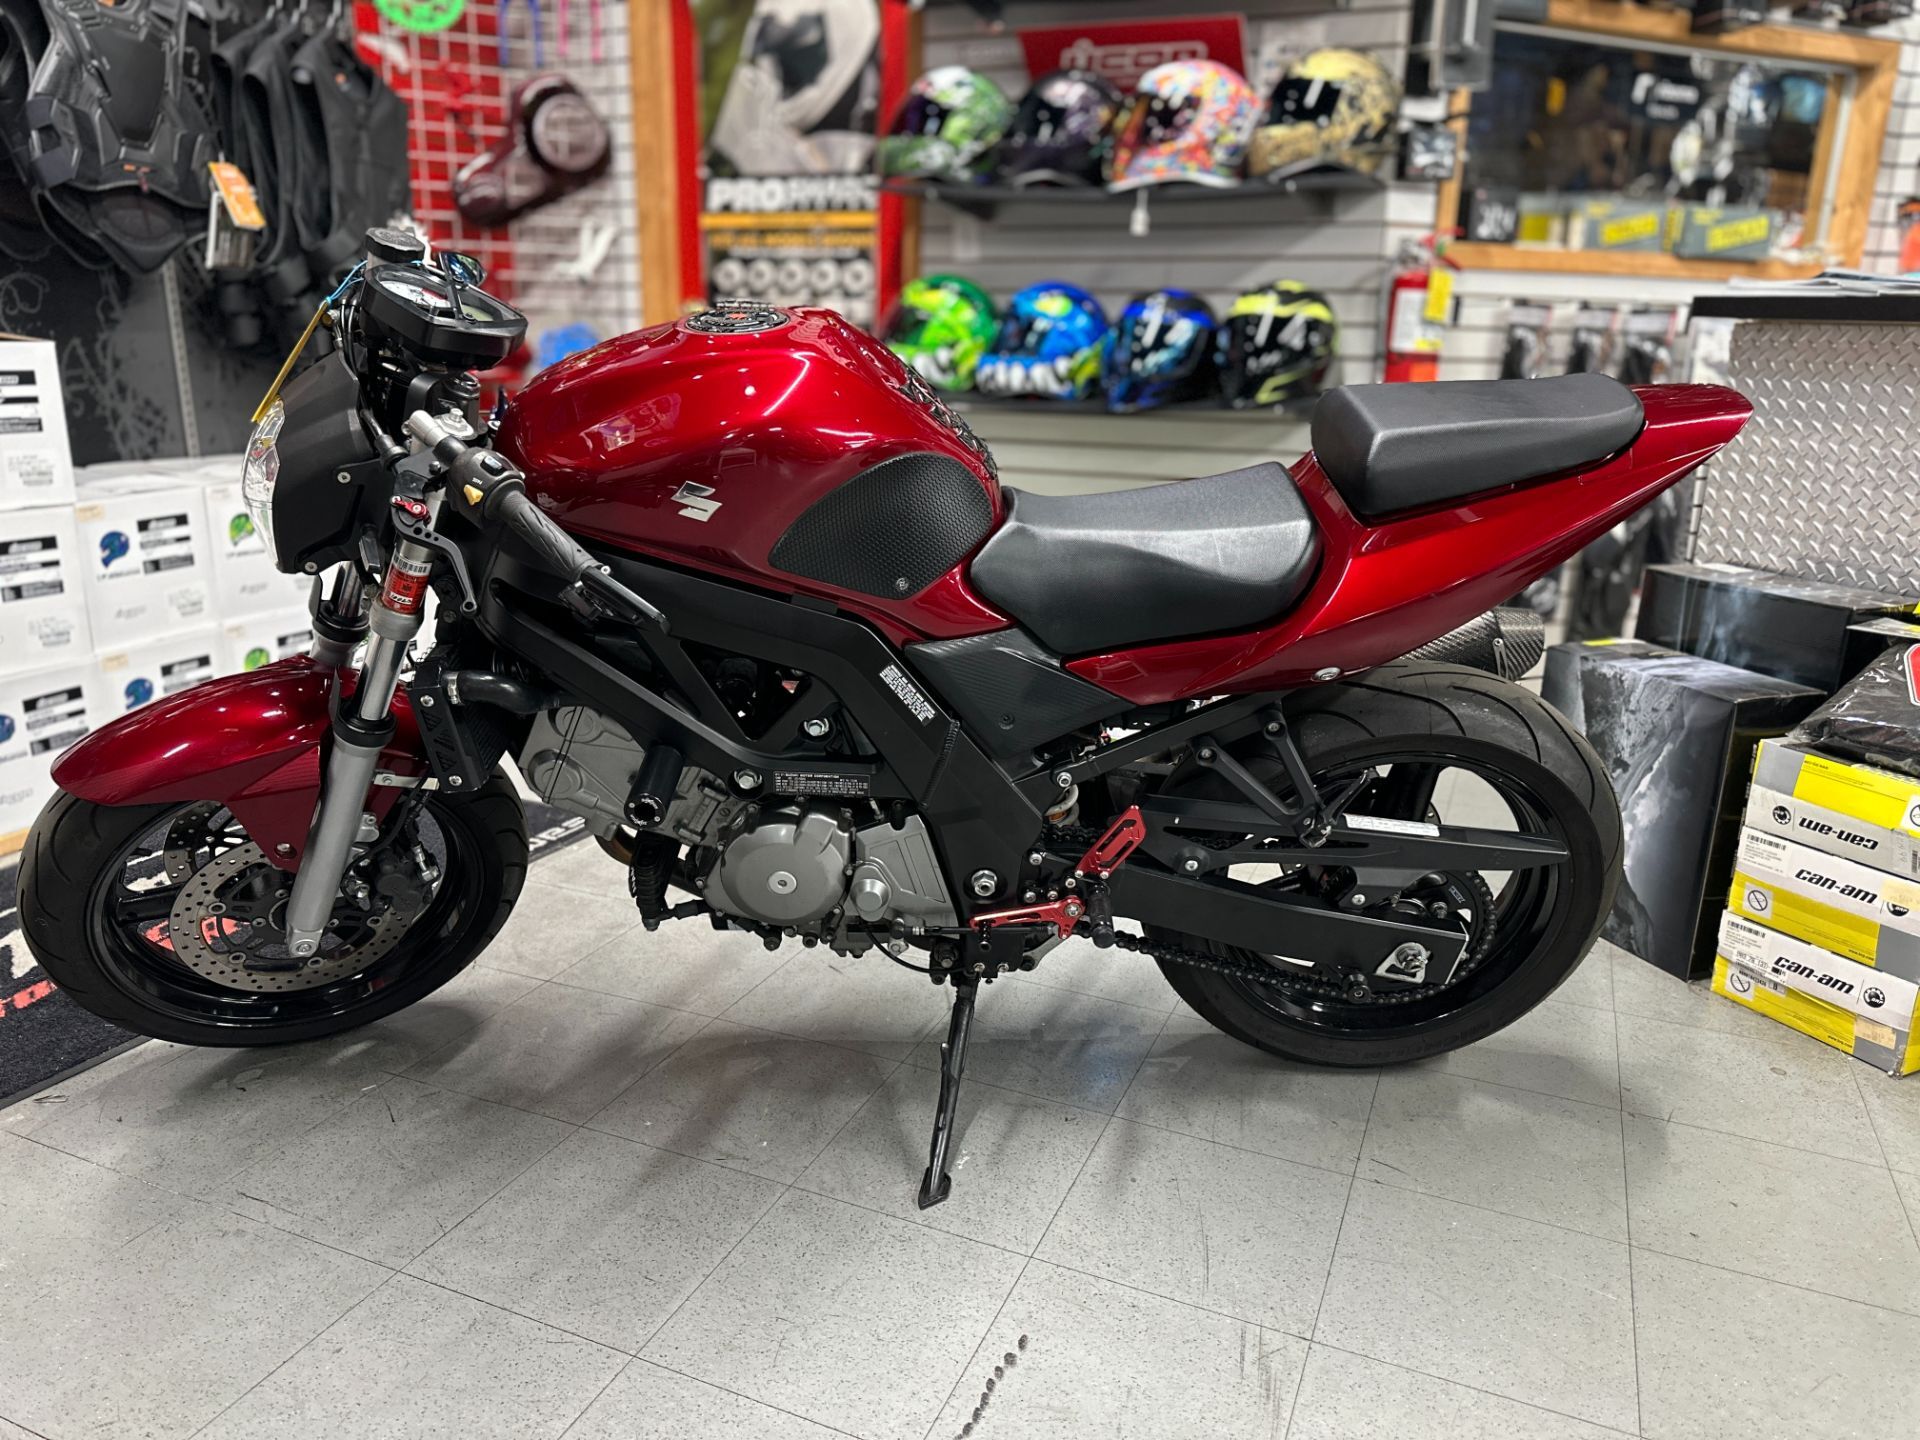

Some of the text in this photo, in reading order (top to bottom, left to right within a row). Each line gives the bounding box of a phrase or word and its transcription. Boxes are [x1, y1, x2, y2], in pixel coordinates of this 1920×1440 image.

[1799, 816, 1879, 851] can-am
[1795, 868, 1878, 904] can-am
[1773, 956, 1855, 995] can-am
